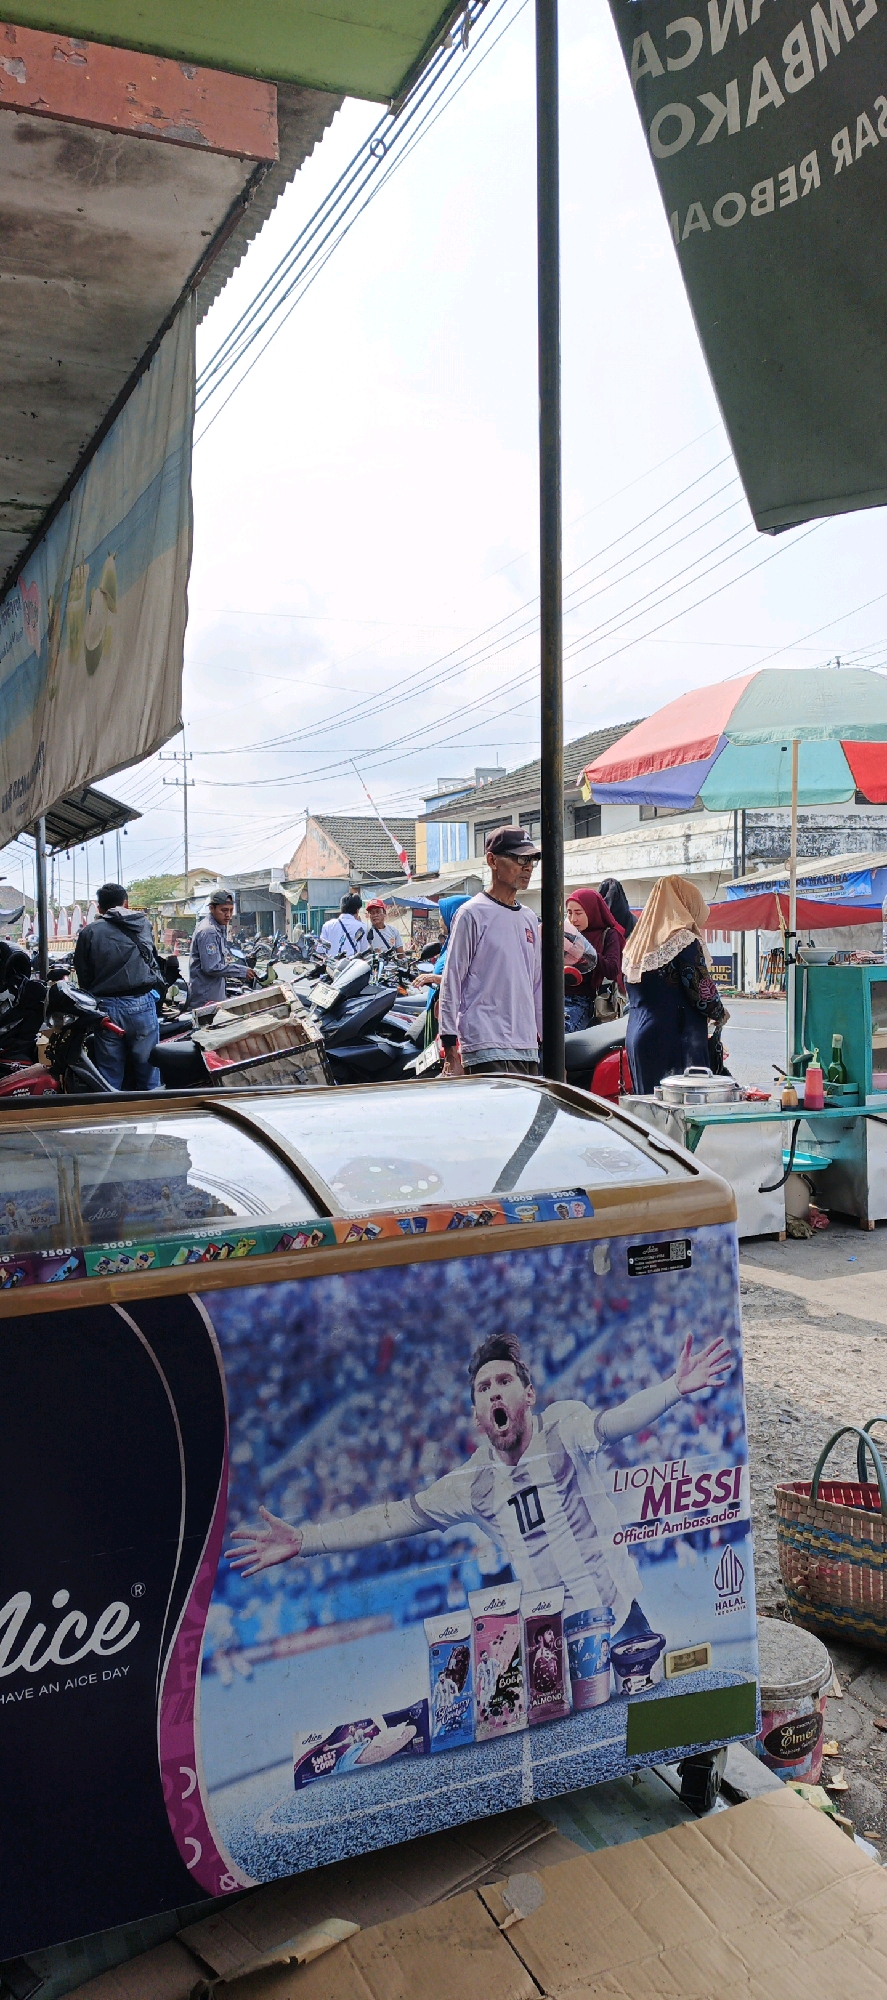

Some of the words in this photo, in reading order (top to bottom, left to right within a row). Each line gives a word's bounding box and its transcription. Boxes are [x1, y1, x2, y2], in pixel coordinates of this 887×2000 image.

[613, 1459, 690, 1493] LIONEL
[640, 1466, 742, 1521] MESSI
[507, 1485, 546, 1535] 10
[613, 1522, 659, 1546] Official
[661, 1508, 741, 1535] Ambassador
[715, 1597, 746, 1611] HALAL
[38, 1681, 60, 1697] AN
[64, 1672, 98, 1690] AICE
[102, 1665, 130, 1681] DAY
[532, 1693, 562, 1707] ALMOND
[311, 1750, 337, 1767] SWEET
[314, 1759, 336, 1774] CORN
